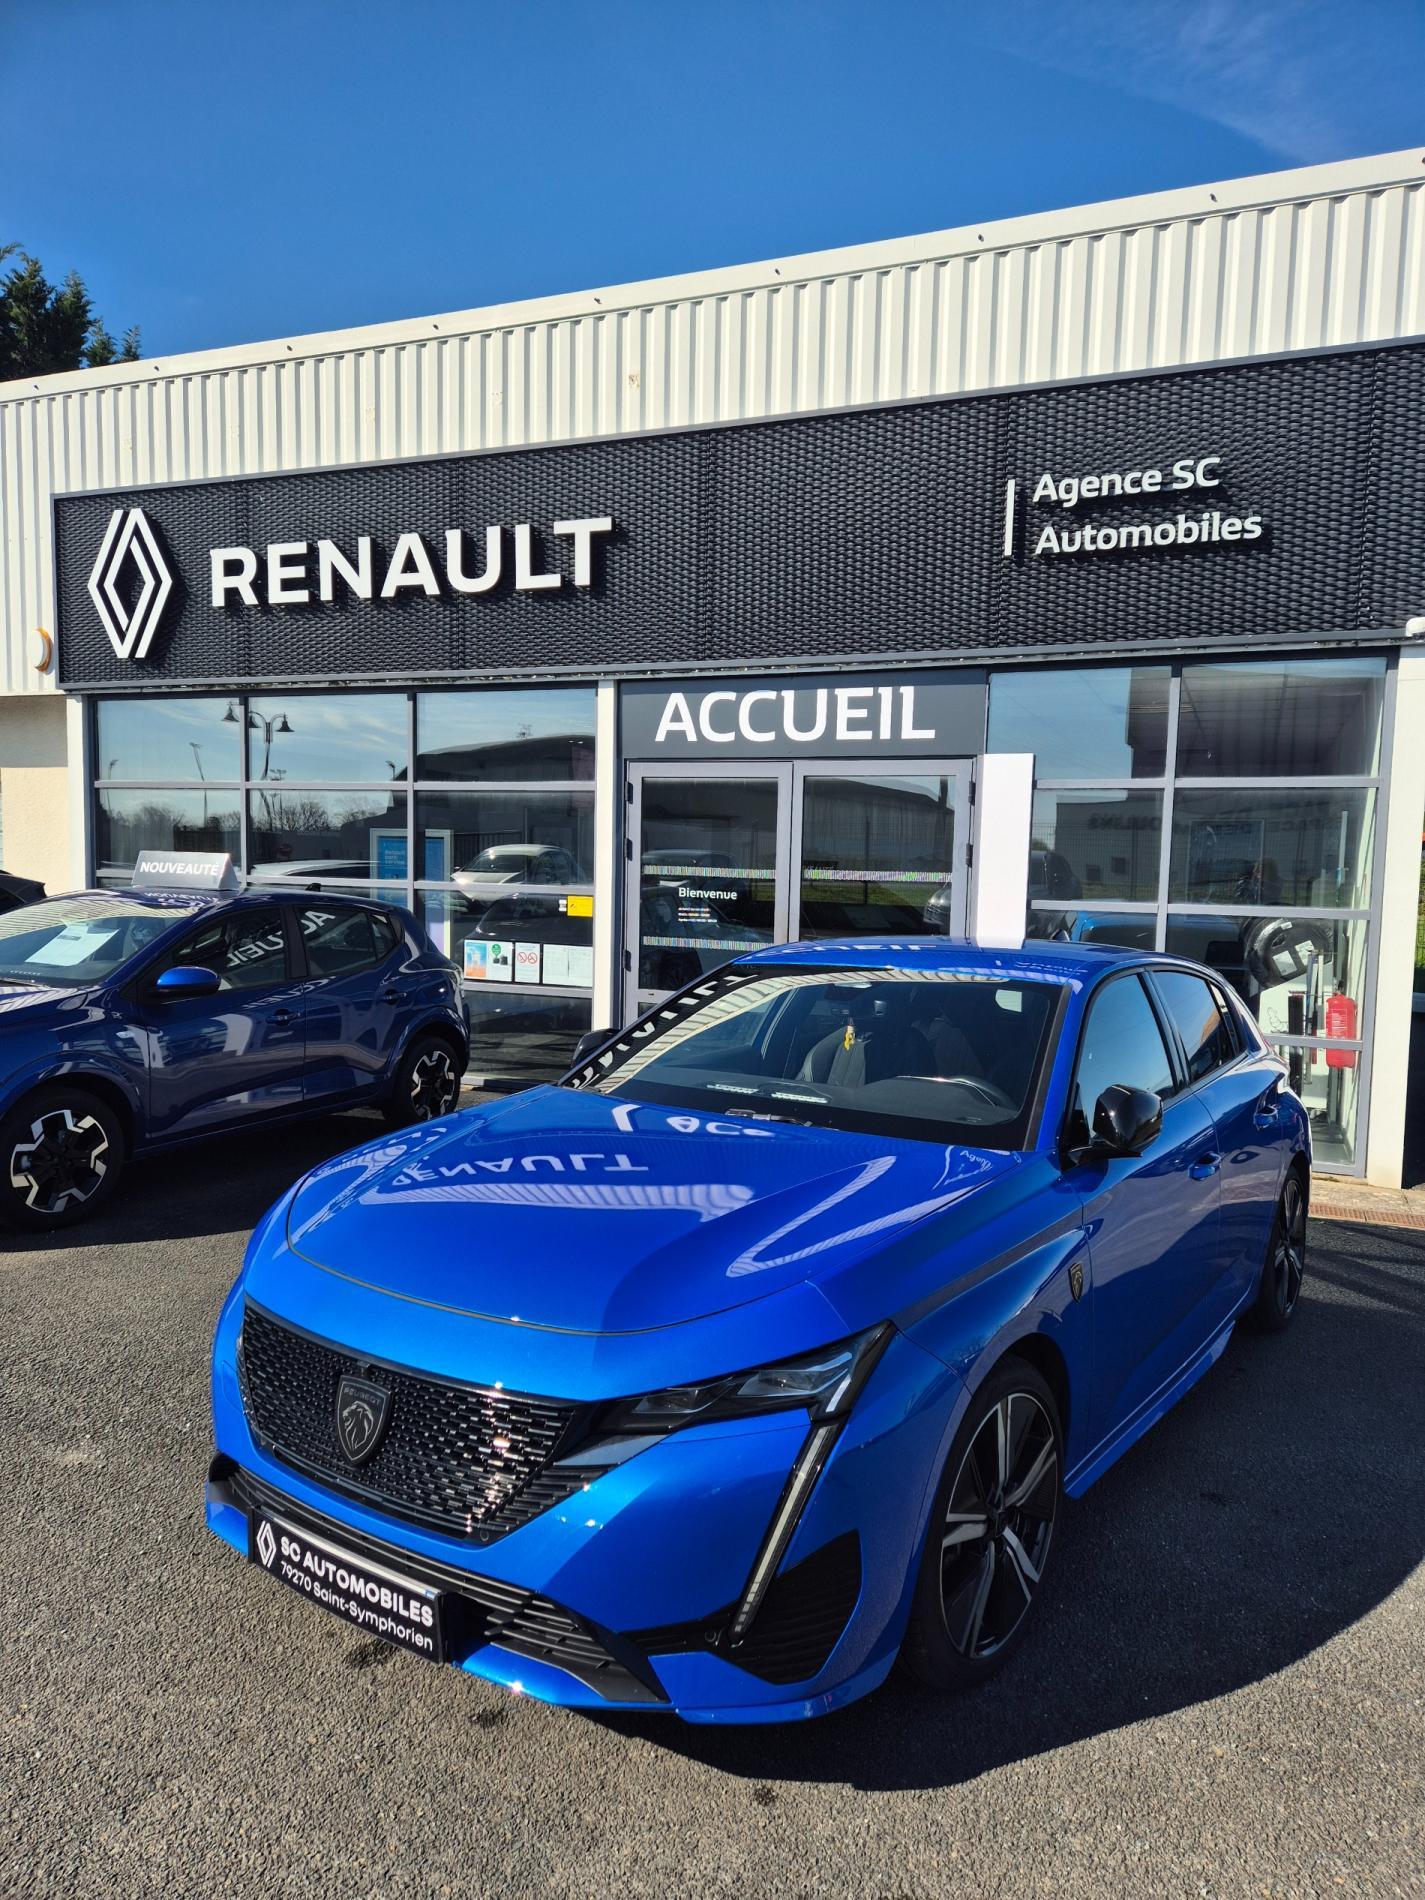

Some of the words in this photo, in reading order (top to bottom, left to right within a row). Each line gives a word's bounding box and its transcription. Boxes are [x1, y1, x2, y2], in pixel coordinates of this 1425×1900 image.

[1032, 469, 1163, 508] Agence
[1170, 456, 1221, 490] SC
[1035, 512, 1264, 556] Automobiles
[209, 516, 614, 608] RENAULT
[654, 685, 936, 743] ACCUEIL
[139, 861, 220, 876] NOUVEAUTÉ
[678, 887, 738, 900] Bienvenue
[343, 1386, 382, 1406] PEUGEOT
[280, 1535, 301, 1562] SC
[302, 1551, 434, 1628] AUTOMOBILES
[280, 1560, 312, 1591] 79270
[313, 1581, 434, 1652] Saint-Symphorien
